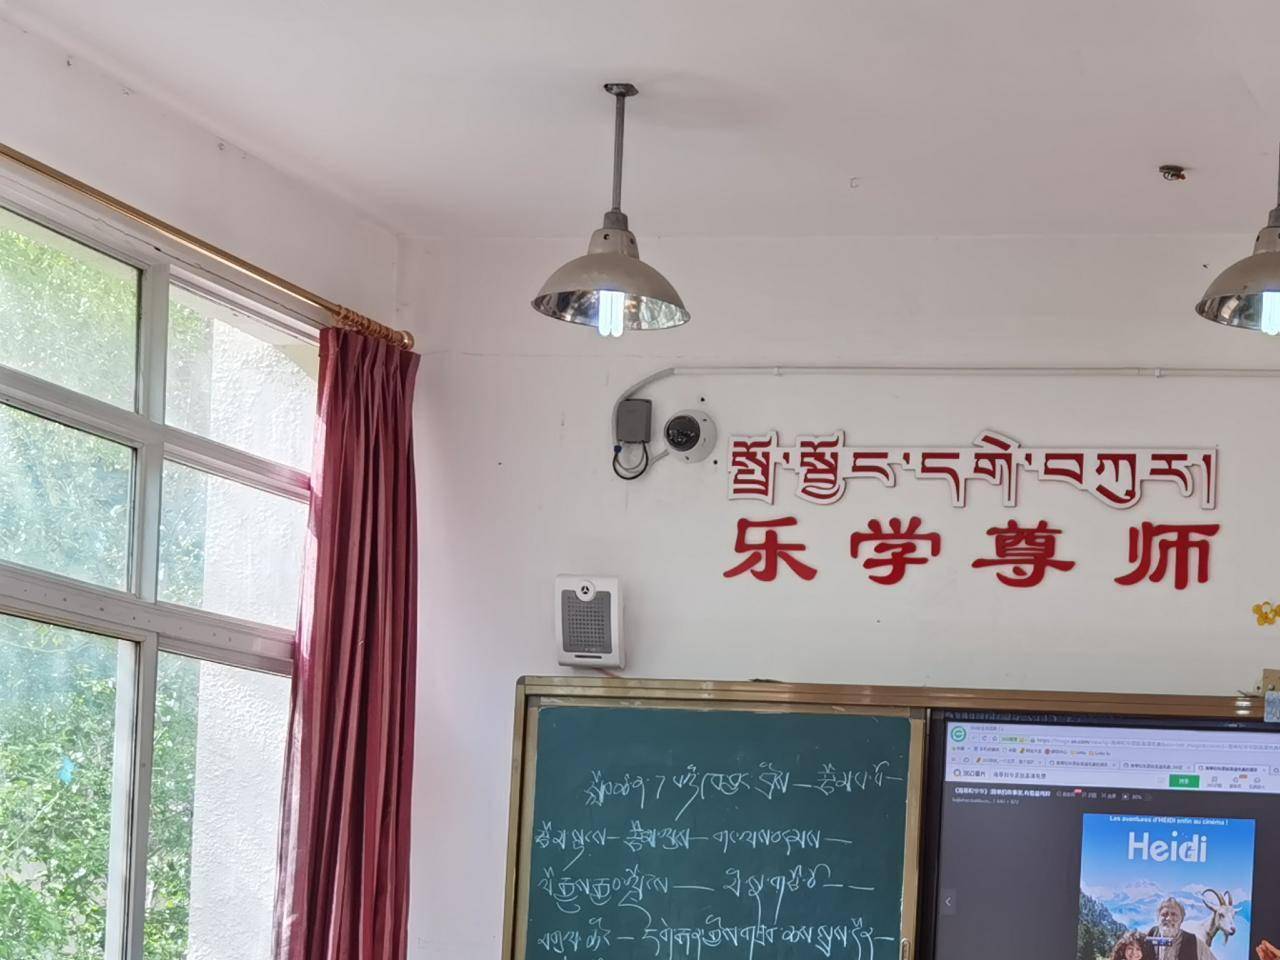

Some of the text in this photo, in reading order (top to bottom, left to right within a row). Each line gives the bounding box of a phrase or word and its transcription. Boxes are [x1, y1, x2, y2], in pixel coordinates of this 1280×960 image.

[723, 516, 1220, 590] 乐学尊师
[1128, 830, 1208, 863] Heidi
